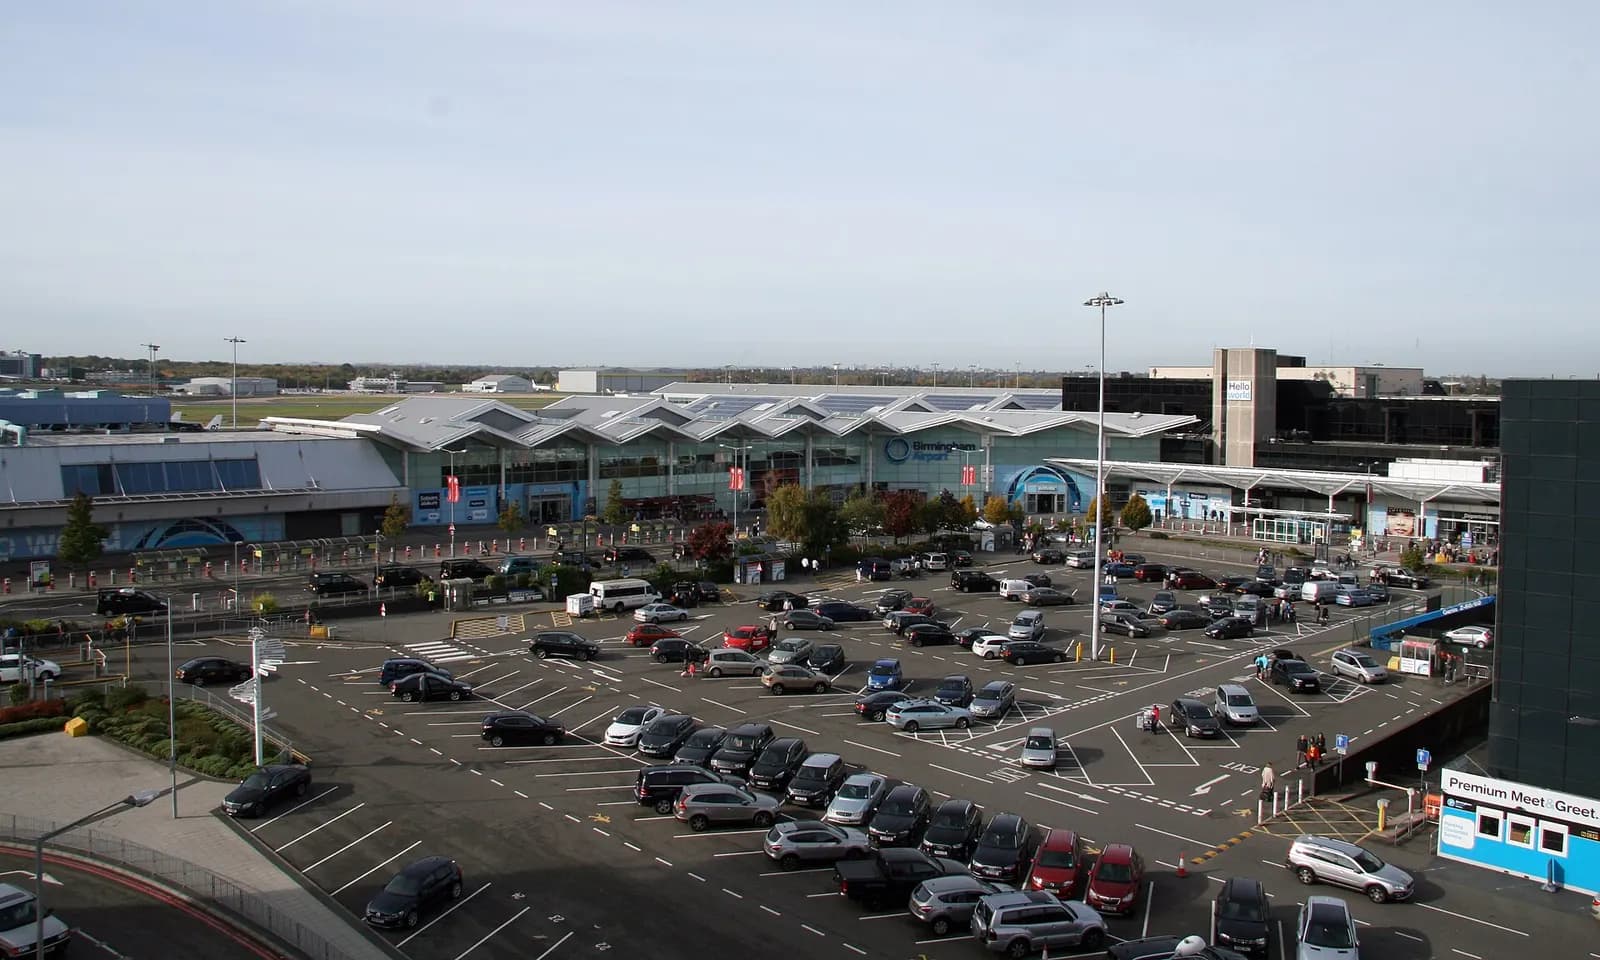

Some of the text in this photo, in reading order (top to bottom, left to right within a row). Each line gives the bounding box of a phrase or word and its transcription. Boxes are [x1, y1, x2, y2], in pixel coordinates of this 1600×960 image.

[1229, 382, 1250, 390] Hello
[1228, 391, 1250, 399] world
[913, 440, 976, 453] Birmingham
[912, 453, 949, 462] Airport
[1219, 761, 1260, 774] EXIT
[1449, 777, 1507, 799] Premium
